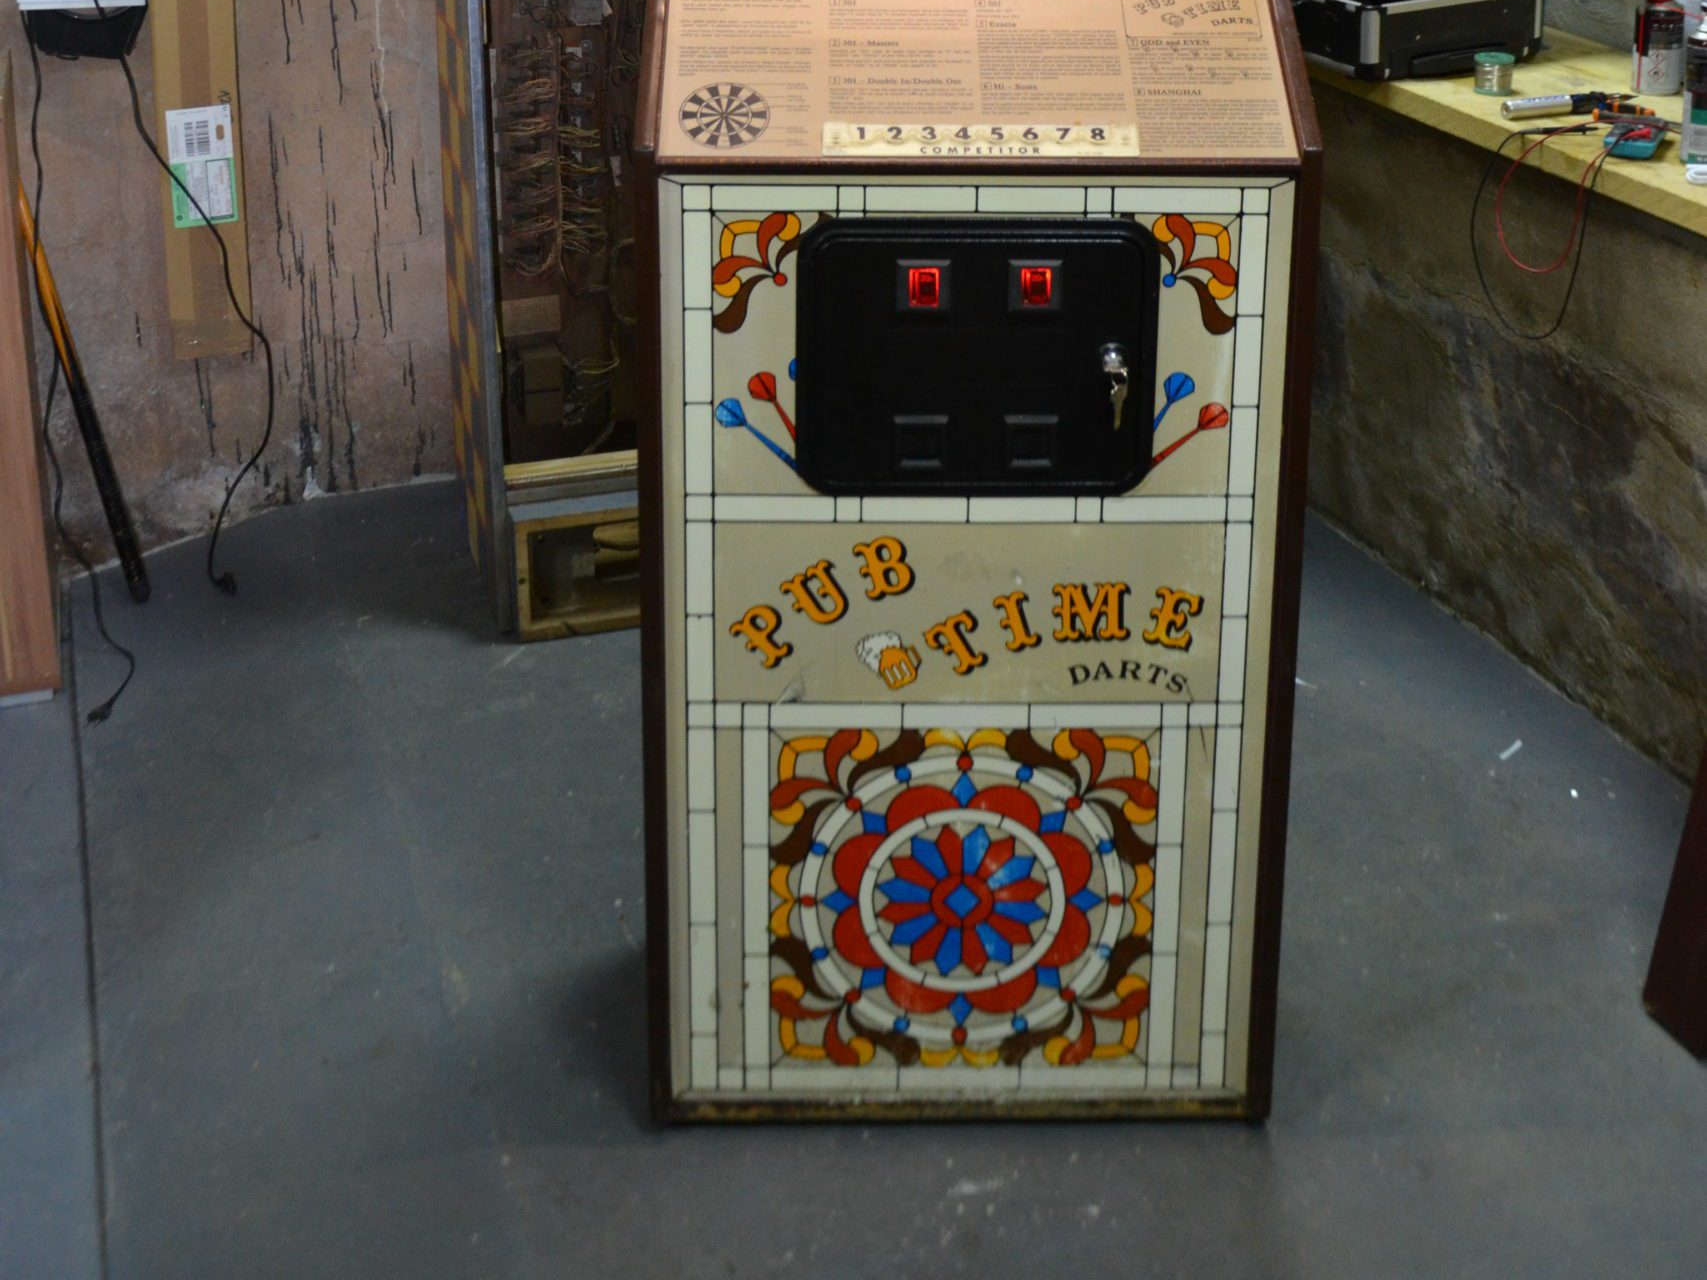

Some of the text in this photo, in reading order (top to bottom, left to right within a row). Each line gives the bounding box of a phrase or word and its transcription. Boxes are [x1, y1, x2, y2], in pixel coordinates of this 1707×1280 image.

[1183, 0, 1241, 19] TIME
[1211, 16, 1254, 27] DARTS
[1183, 39, 1210, 47] EVEN
[857, 126, 1105, 141] 1 2 3 4 5 6 7 8
[920, 146, 1040, 154] COMPETITOR
[730, 535, 1205, 677] PUB TIME
[1070, 660, 1189, 694] DARTS
